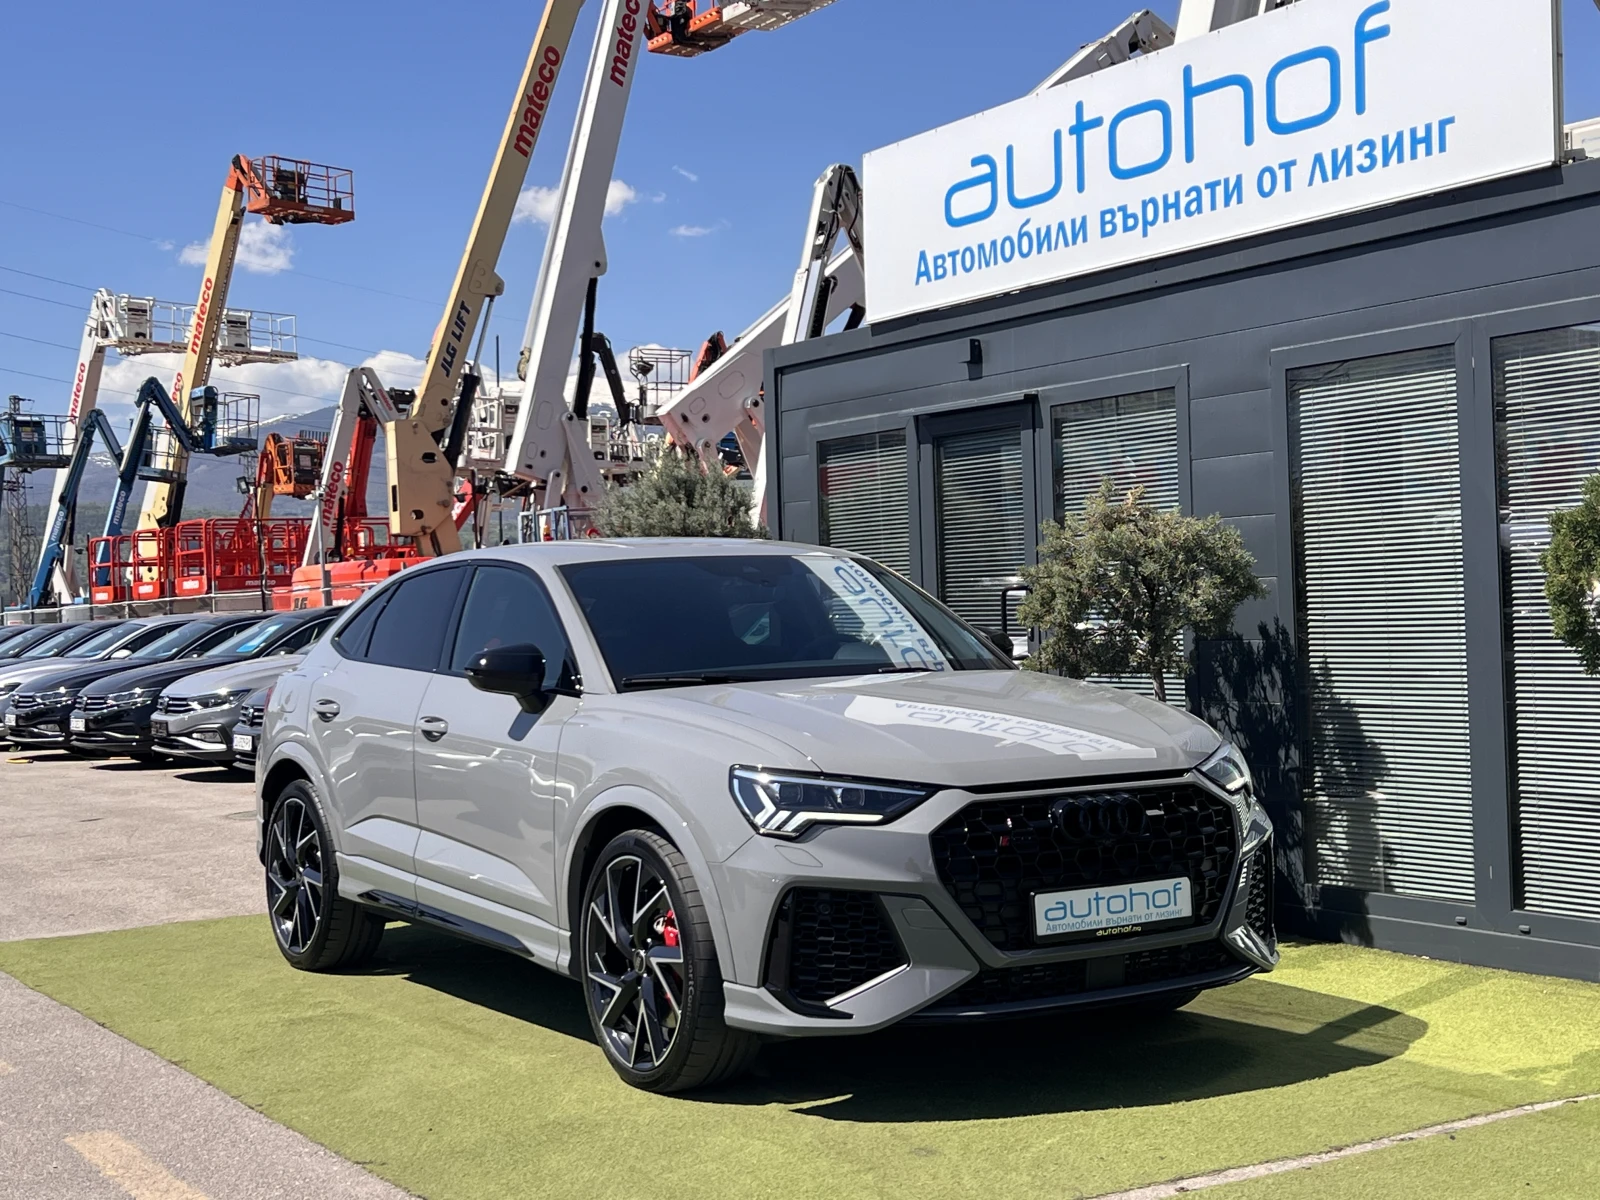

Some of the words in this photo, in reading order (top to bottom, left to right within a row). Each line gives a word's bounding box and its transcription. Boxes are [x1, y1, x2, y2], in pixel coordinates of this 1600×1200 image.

[609, 0, 640, 88] matec
[513, 45, 561, 158] mateco
[944, 0, 1391, 228] autohof
[914, 215, 1089, 286] Автомобили
[1100, 174, 1244, 238] върнати
[1257, 159, 1298, 198] от
[1308, 115, 1456, 187] лизинг
[190, 277, 213, 355] mateco
[441, 341, 458, 378] JLG
[451, 300, 471, 343] LIFT
[50, 510, 65, 541] mateco
[113, 490, 126, 525] mateco
[322, 461, 344, 527] mateco
[1044, 882, 1182, 922] autohof
[1045, 919, 1103, 933] Автомобили
[1105, 914, 1142, 926] върнати
[1144, 912, 1153, 921] от
[1155, 908, 1183, 919] лизинг
